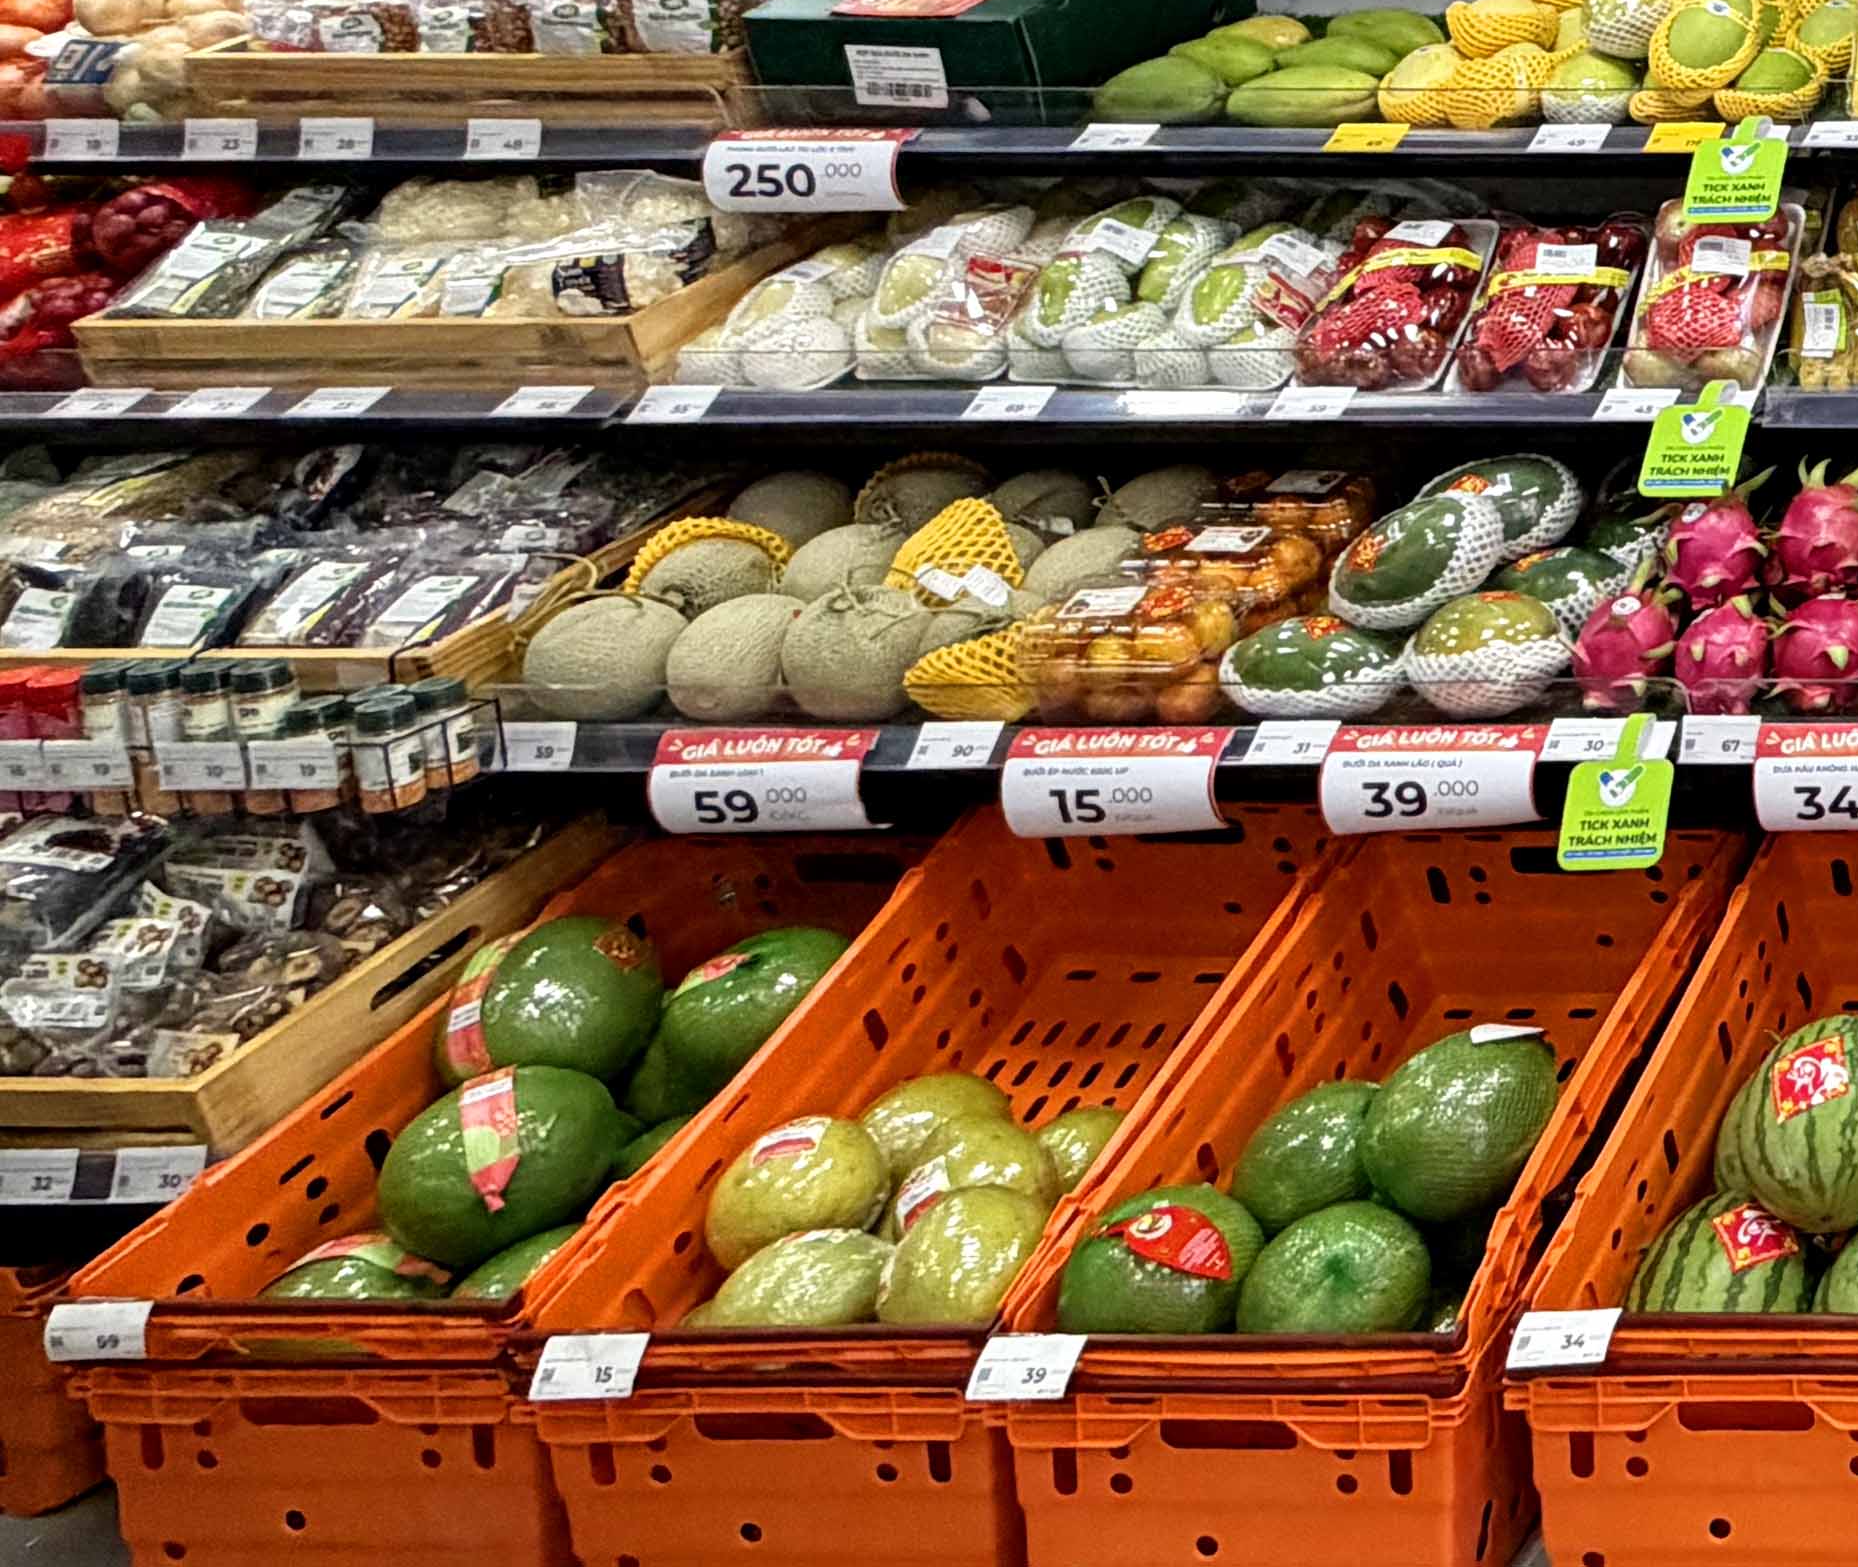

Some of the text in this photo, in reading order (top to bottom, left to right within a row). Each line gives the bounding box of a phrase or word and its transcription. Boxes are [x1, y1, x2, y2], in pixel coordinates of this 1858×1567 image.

[1703, 182, 1765, 195] TICK XANH
[1691, 191, 1771, 207] TRÁCH NHIỆM
[1661, 451, 1725, 464] TICK XANH
[1649, 463, 1731, 480] TRÁCH NHIỆM
[682, 733, 822, 760] GIÁ LUÔN TỐT
[1035, 732, 1175, 755] GIÁ LUÔN TỐT
[1356, 727, 1499, 750] GIÁ LUÔN TỐT
[1583, 740, 1604, 752] 30
[1720, 738, 1741, 753] 67
[1780, 731, 1818, 755] GIÁ
[951, 745, 975, 758] 90
[1293, 742, 1310, 755] 31
[1049, 789, 1106, 824] 15
[1362, 780, 1479, 818] 39 .000
[1580, 818, 1650, 831] TICK XANH
[1568, 831, 1657, 847] TRÁCH NHIỆM
[31, 1175, 54, 1192] 32
[158, 1174, 182, 1191] 30
[1560, 1332, 1586, 1350] 34
[594, 1365, 614, 1384] 15
[1019, 1366, 1049, 1385] 39
